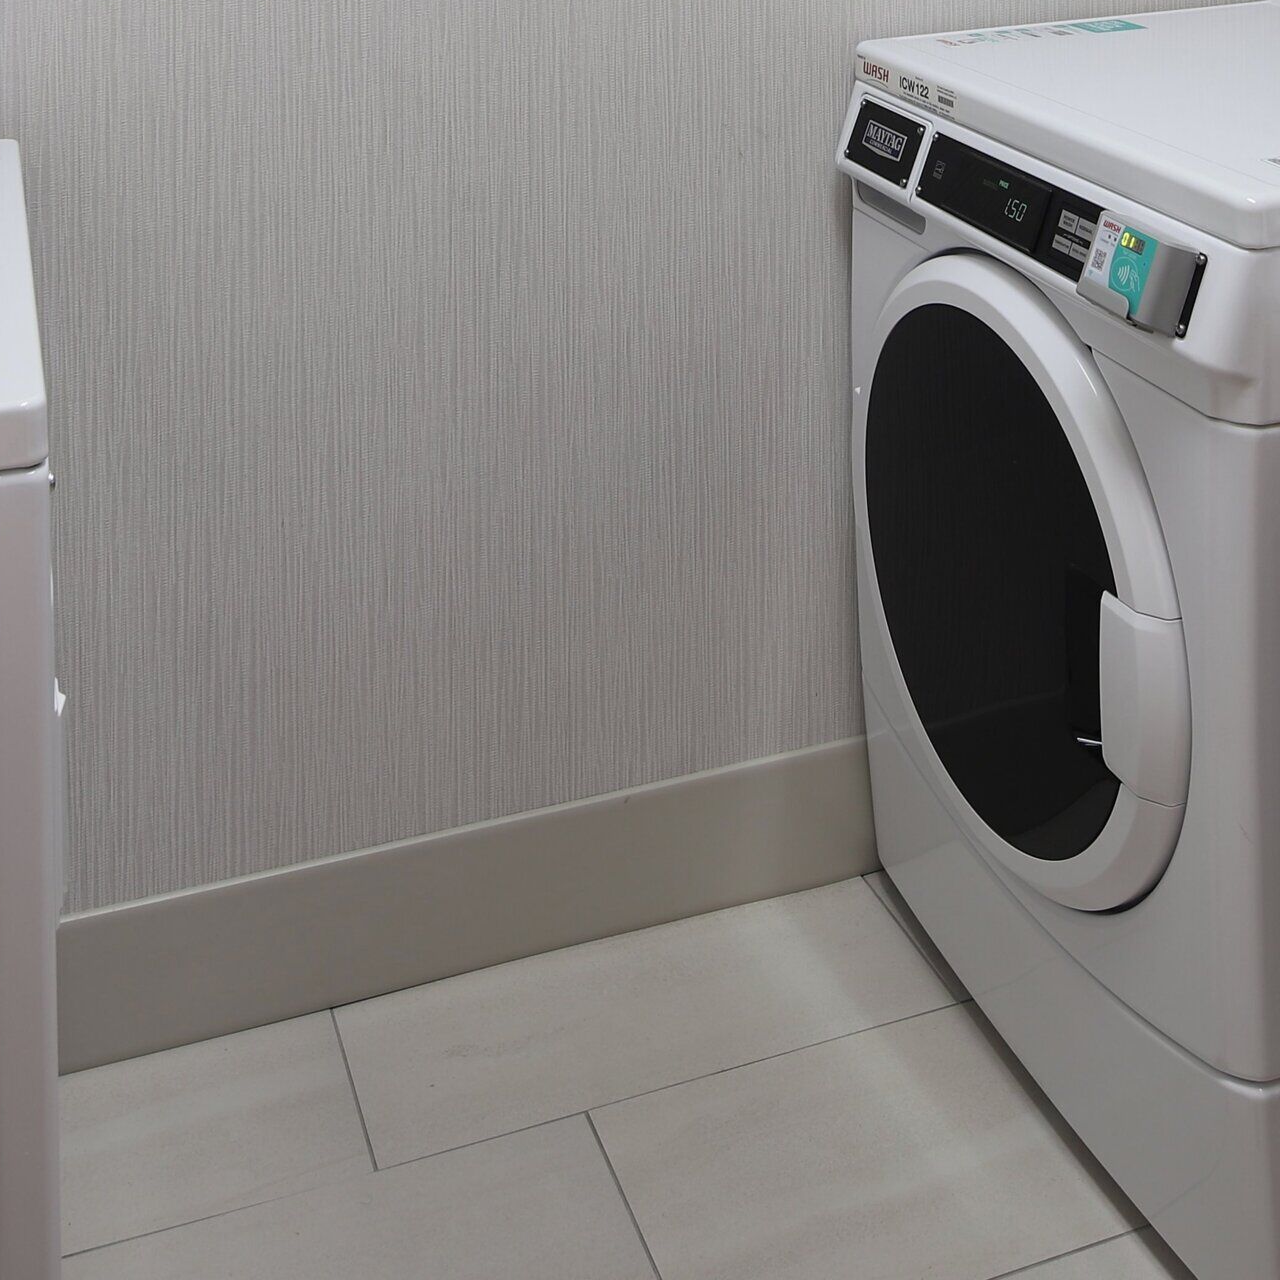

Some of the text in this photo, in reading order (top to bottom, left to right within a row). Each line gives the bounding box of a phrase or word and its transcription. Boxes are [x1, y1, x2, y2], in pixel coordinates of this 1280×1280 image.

[863, 61, 889, 83] WASH
[866, 123, 903, 151] MAYTAG
[1103, 219, 1122, 234] WASH
